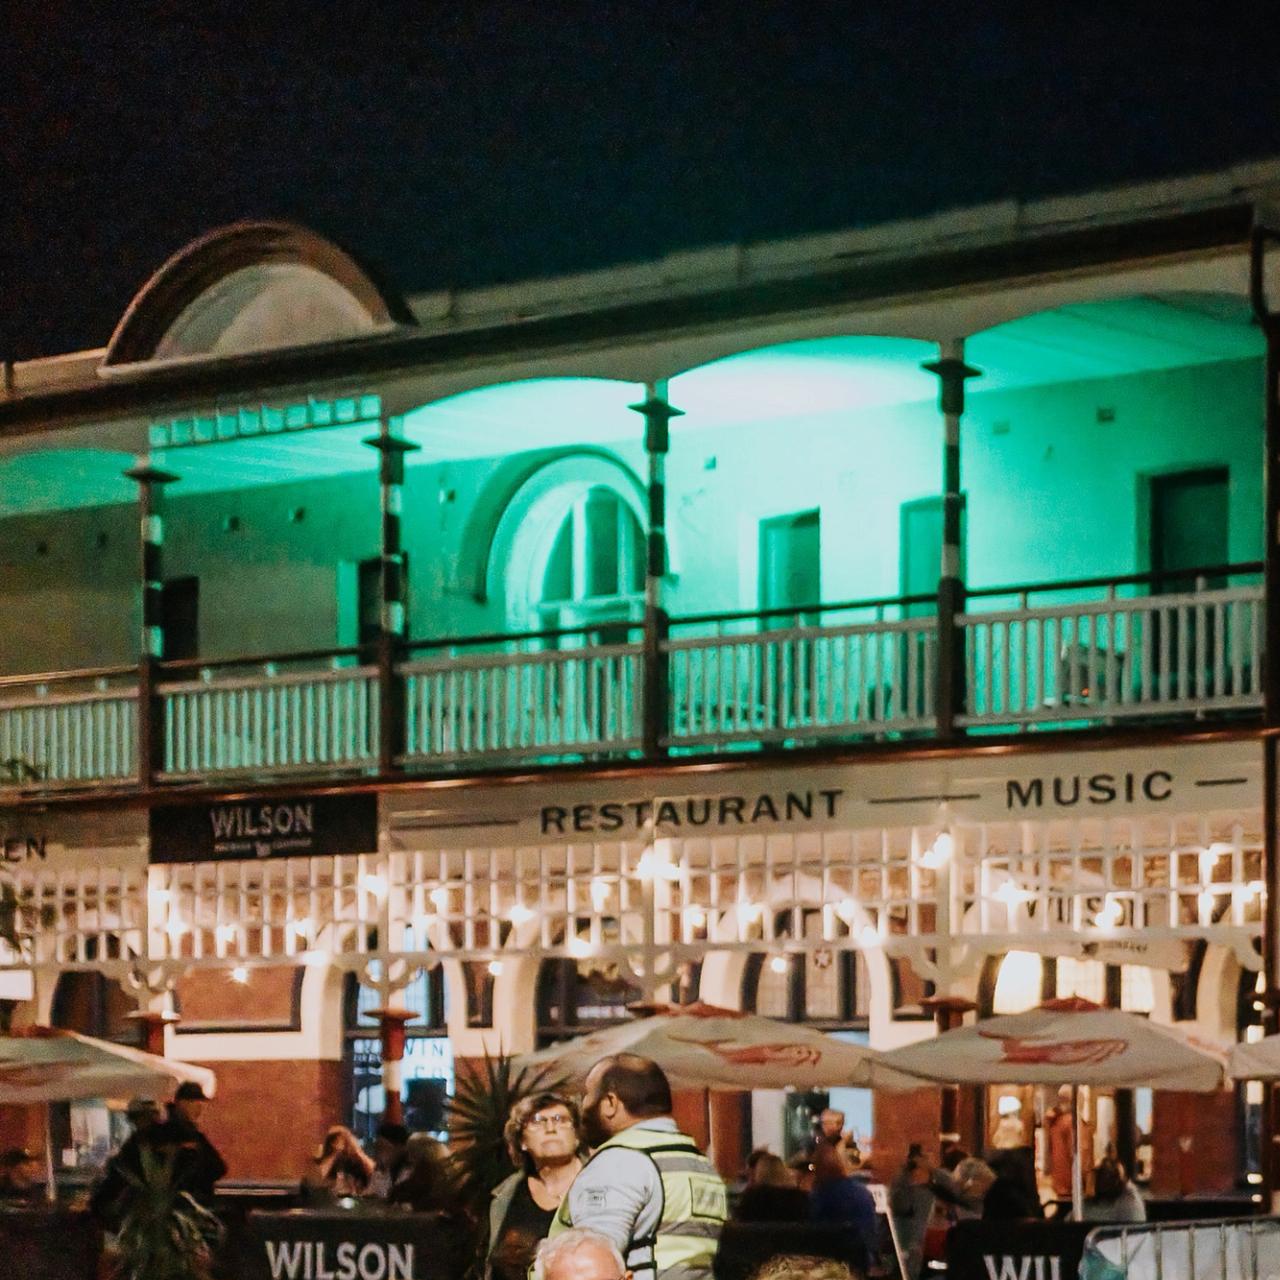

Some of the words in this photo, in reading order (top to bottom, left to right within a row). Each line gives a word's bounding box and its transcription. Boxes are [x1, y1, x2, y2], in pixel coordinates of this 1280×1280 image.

[210, 803, 314, 838] WILSON
[540, 789, 844, 834] RESTAURANT
[1006, 770, 1172, 810] MUSIC
